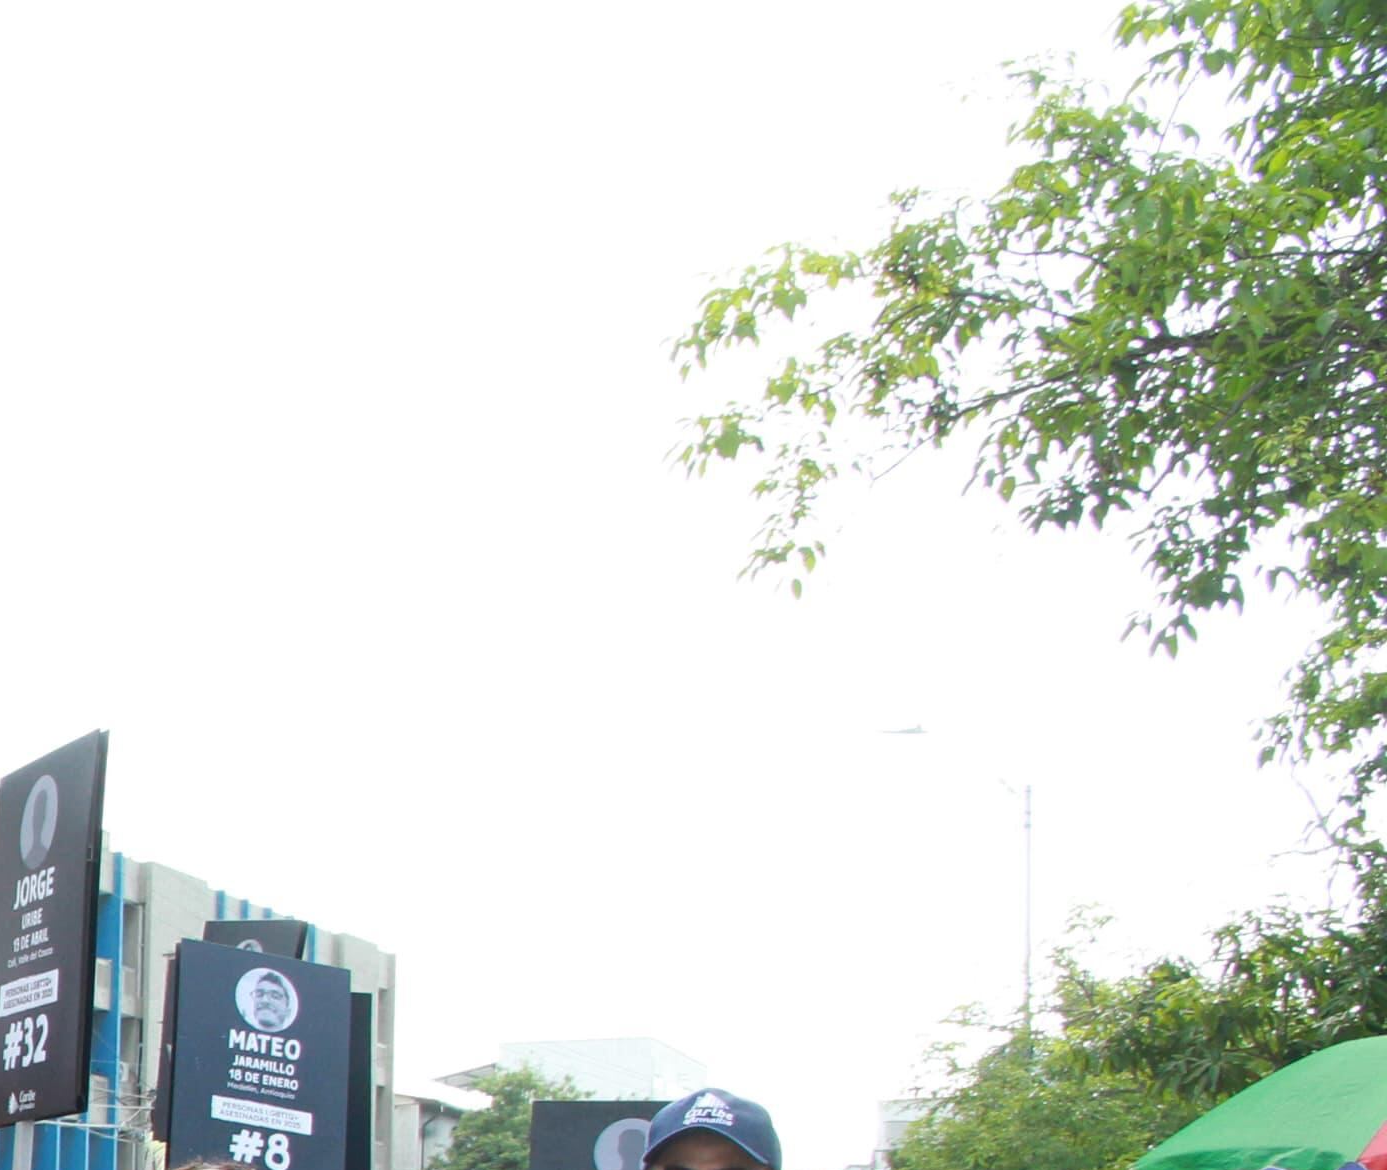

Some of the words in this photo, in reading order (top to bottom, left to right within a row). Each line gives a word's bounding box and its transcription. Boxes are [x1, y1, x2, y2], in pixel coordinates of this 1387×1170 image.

[13, 866, 56, 911] JORGE
[21, 908, 43, 930] URIBE
[21, 934, 30, 951] DE
[30, 928, 48, 949] ABRIL
[3, 1013, 48, 1071] #32
[229, 1029, 301, 1061] MATEO
[233, 1055, 294, 1076] JARAMILLO
[229, 1069, 242, 1081] 18
[245, 1072, 259, 1084] DE
[262, 1075, 299, 1091] ENERO
